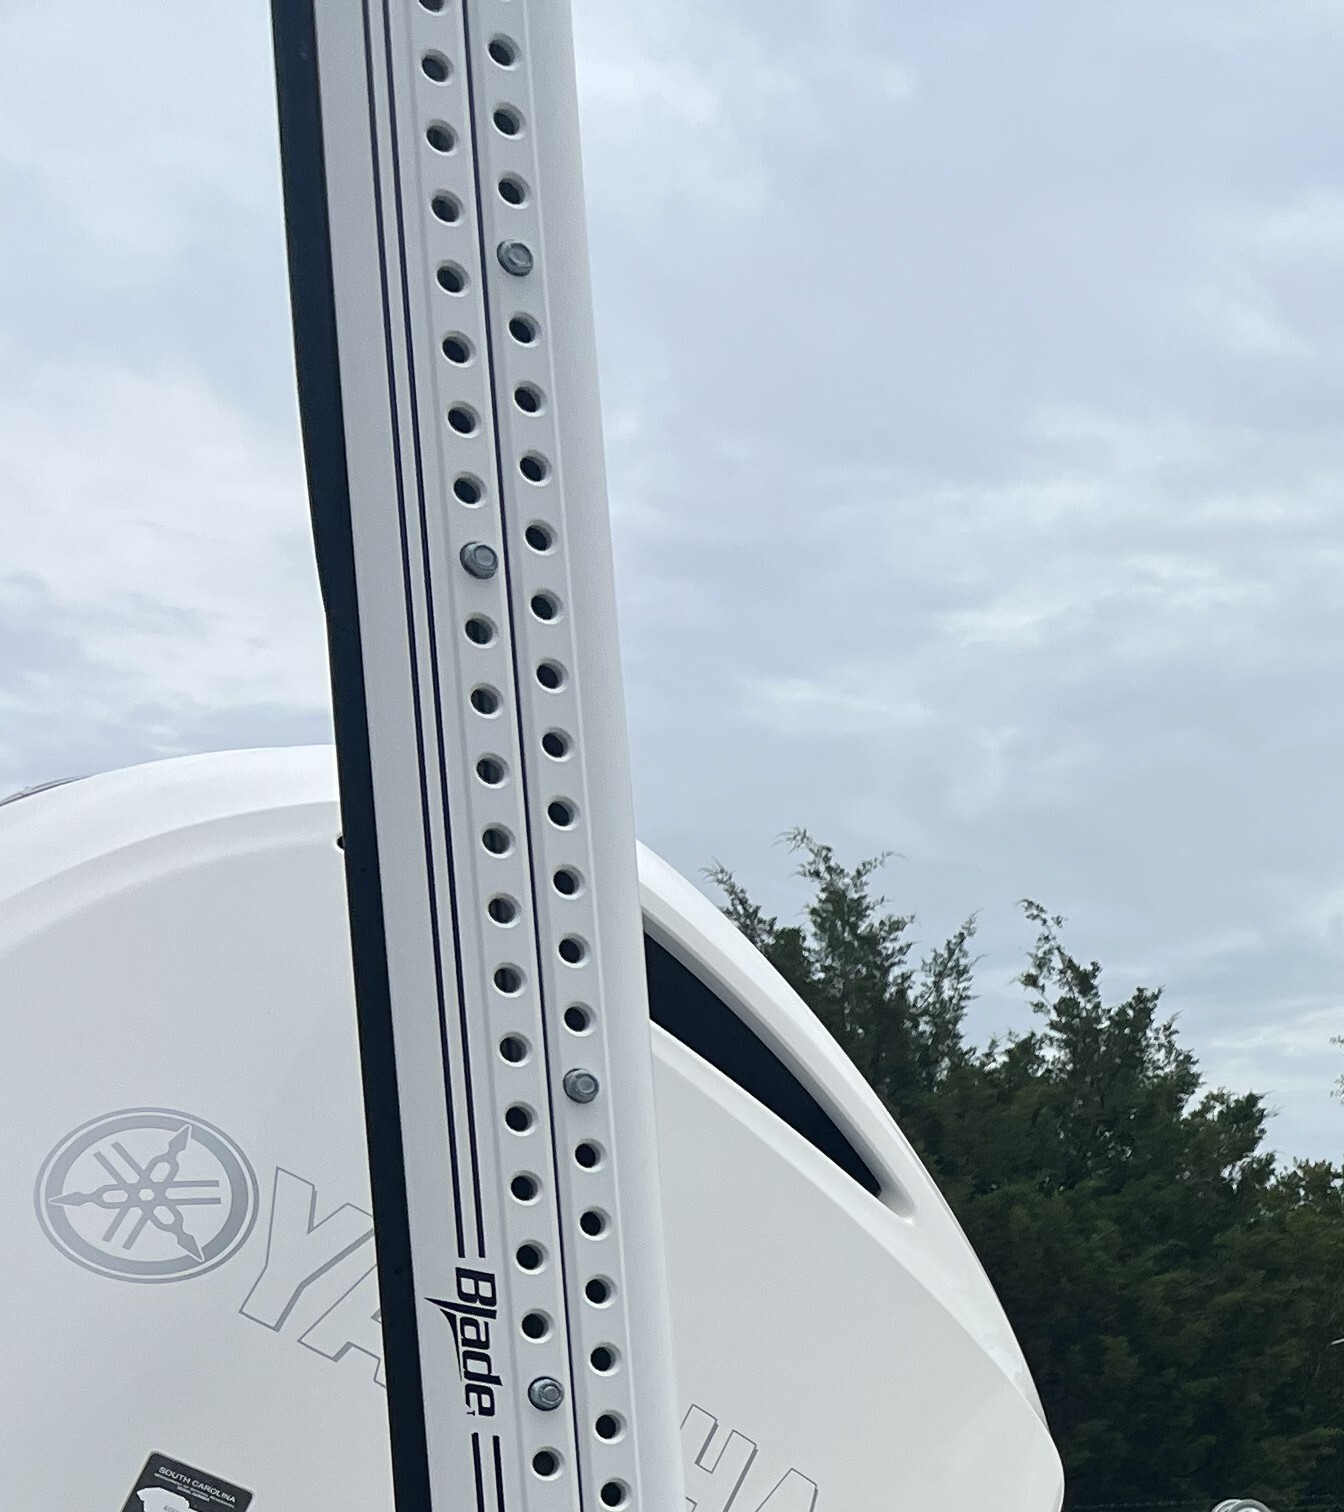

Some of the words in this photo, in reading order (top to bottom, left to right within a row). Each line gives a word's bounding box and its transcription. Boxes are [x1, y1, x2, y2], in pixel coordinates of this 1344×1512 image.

[424, 1266, 504, 1418] Blade
[158, 1466, 191, 1485] SOUTH
[191, 1479, 236, 1504] CAROLINA
